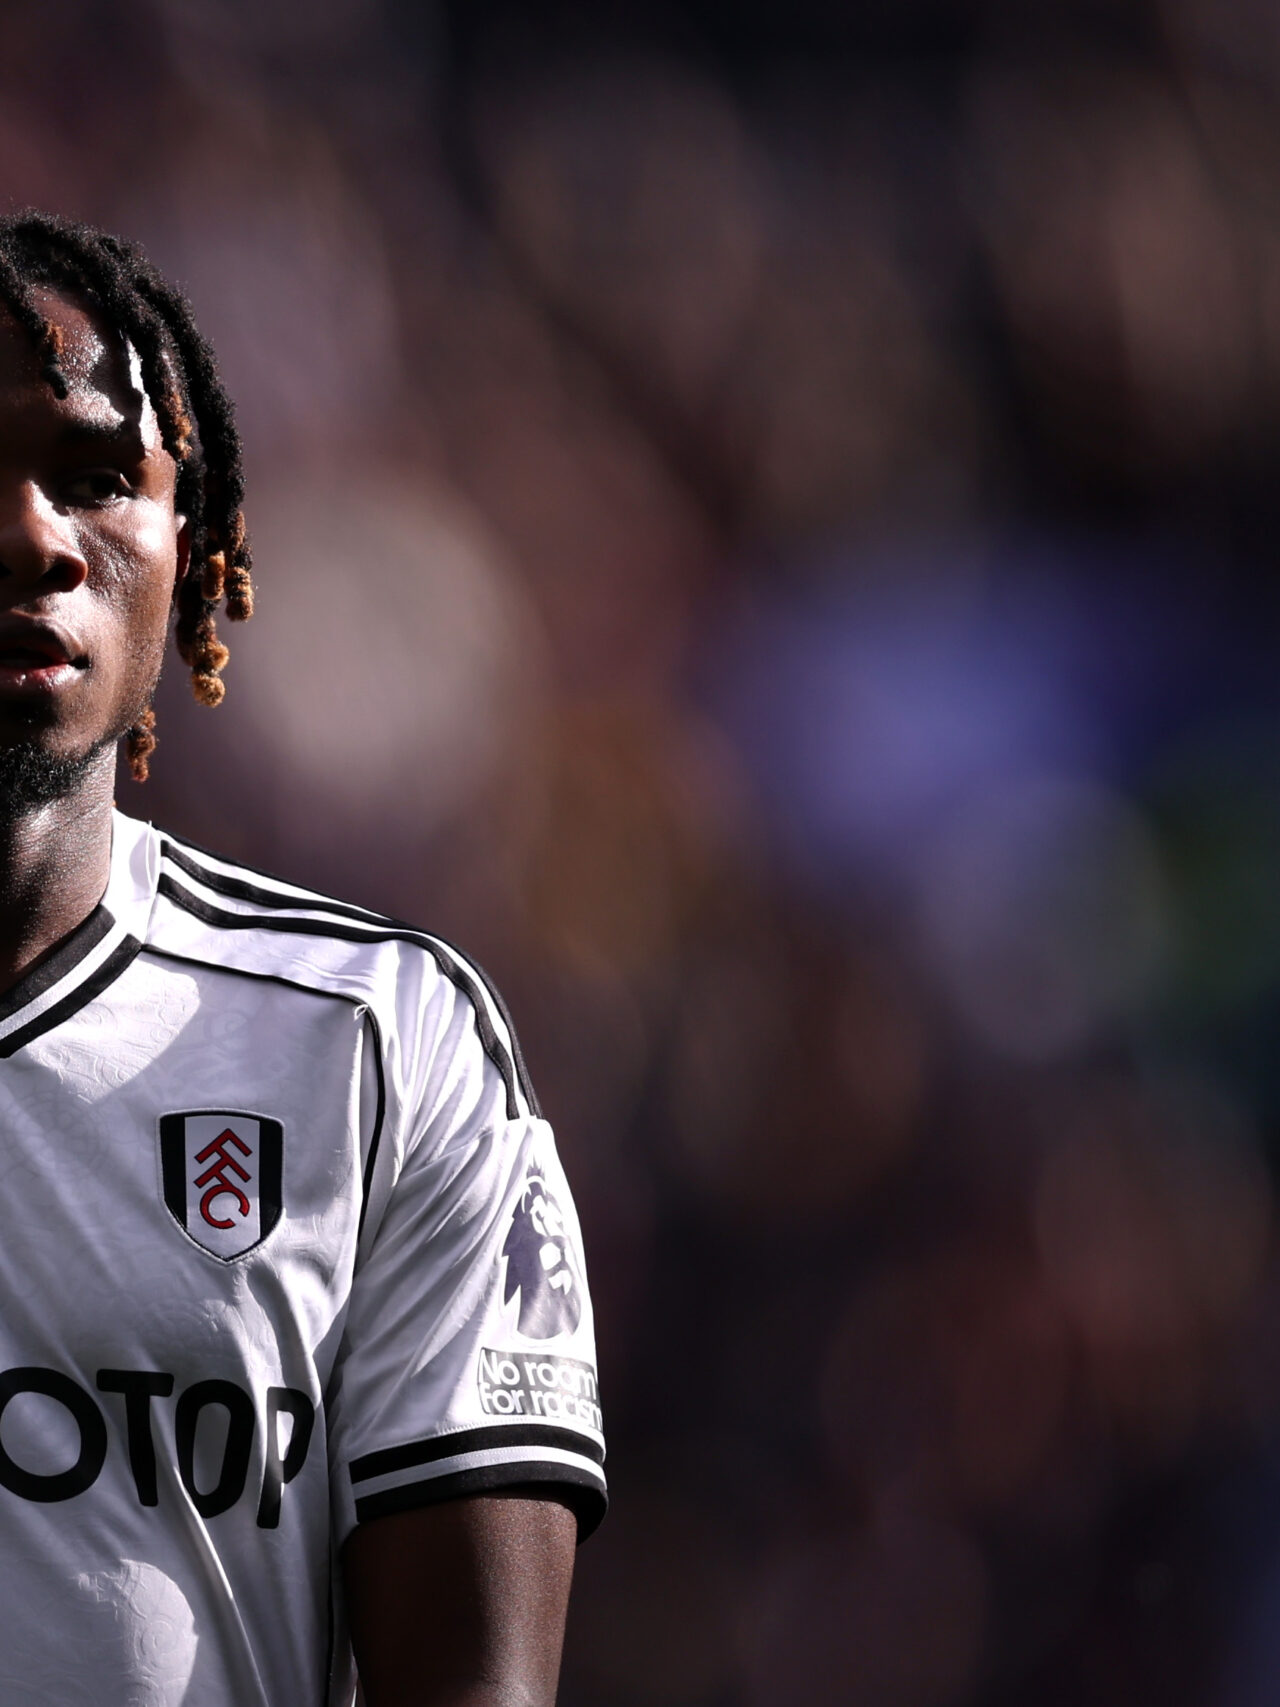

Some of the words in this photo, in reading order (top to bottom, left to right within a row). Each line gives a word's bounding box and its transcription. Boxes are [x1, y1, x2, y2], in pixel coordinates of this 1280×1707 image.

[194, 1129, 252, 1228] FFC
[479, 1350, 520, 1386] No
[524, 1362, 597, 1400] room
[480, 1382, 524, 1413] for
